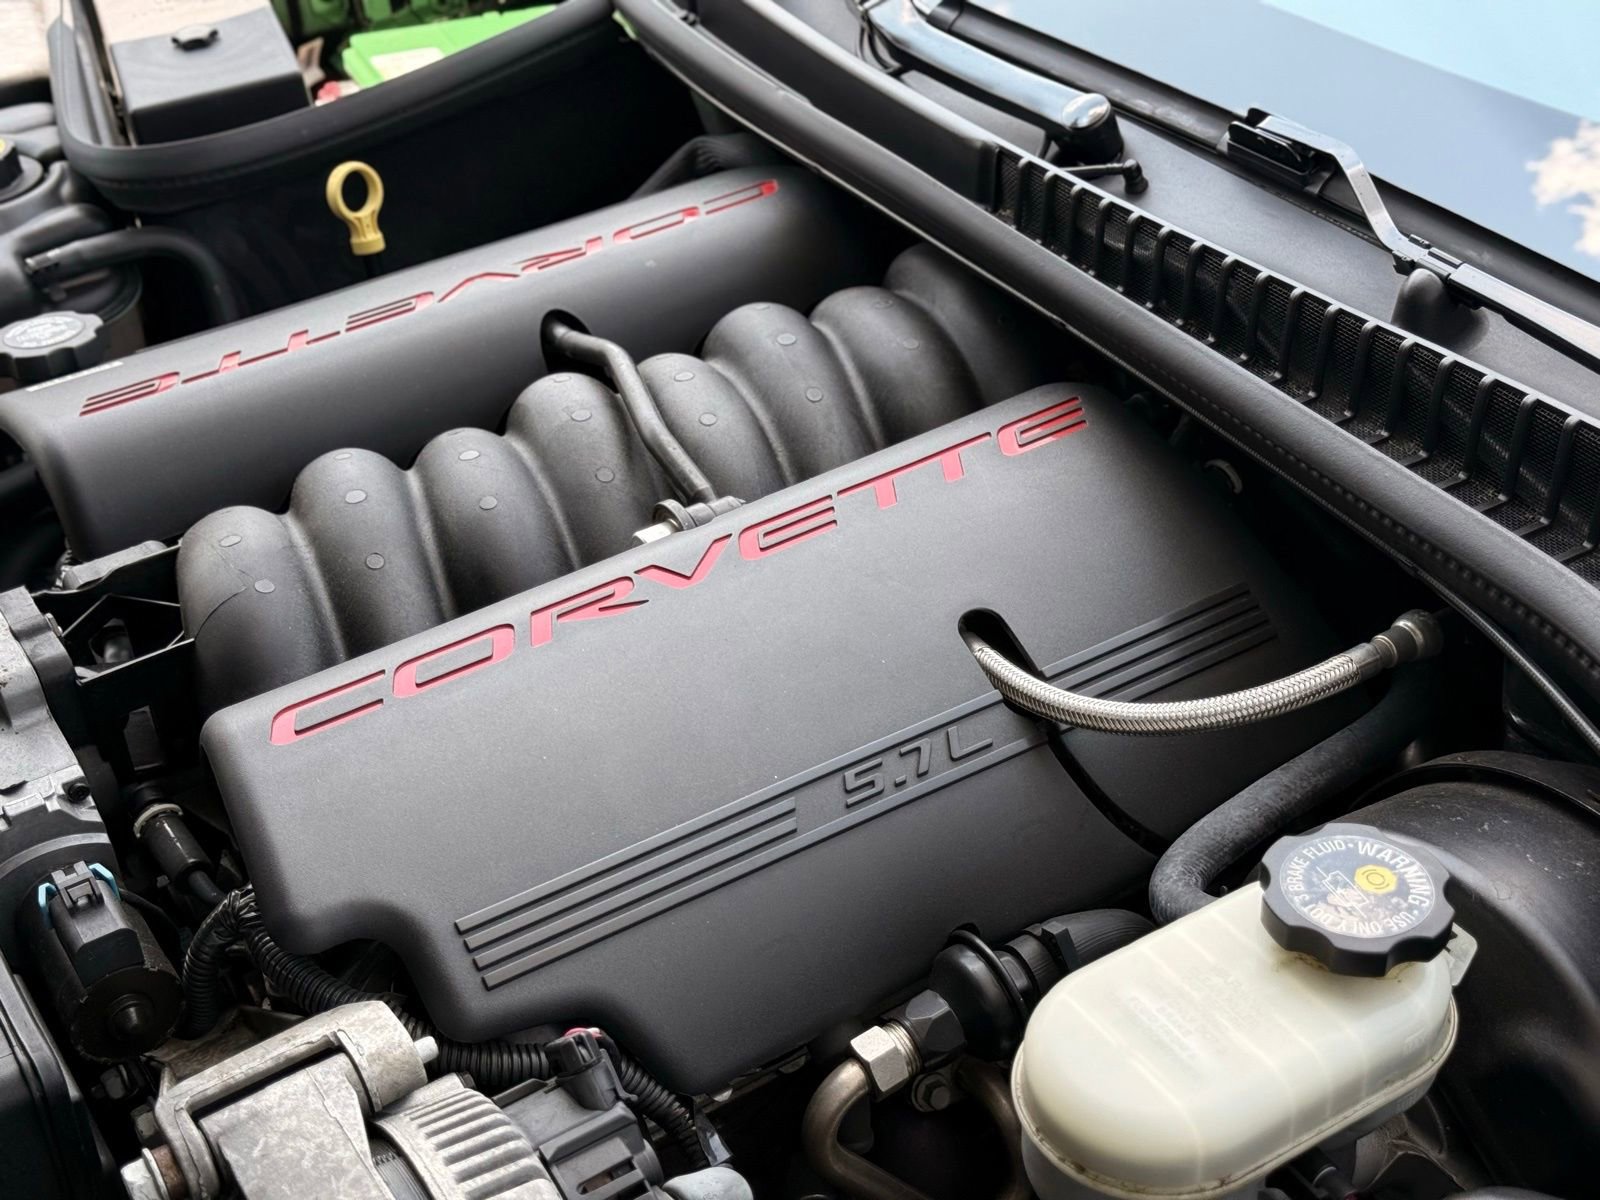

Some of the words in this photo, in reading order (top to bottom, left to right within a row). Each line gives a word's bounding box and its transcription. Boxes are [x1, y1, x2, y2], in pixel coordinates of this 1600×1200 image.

[79, 179, 779, 416] CORVETTE
[270, 395, 1089, 746] CORVETTE
[844, 725, 994, 809] 5.7L
[1303, 839, 1347, 860] FLUID
[1286, 856, 1310, 893] BRAKE
[1357, 840, 1431, 908] WARNING
[1294, 893, 1310, 903] 3
[1300, 903, 1335, 927] DOT
[1336, 919, 1384, 936] ONLY
[1382, 911, 1416, 931] USE
